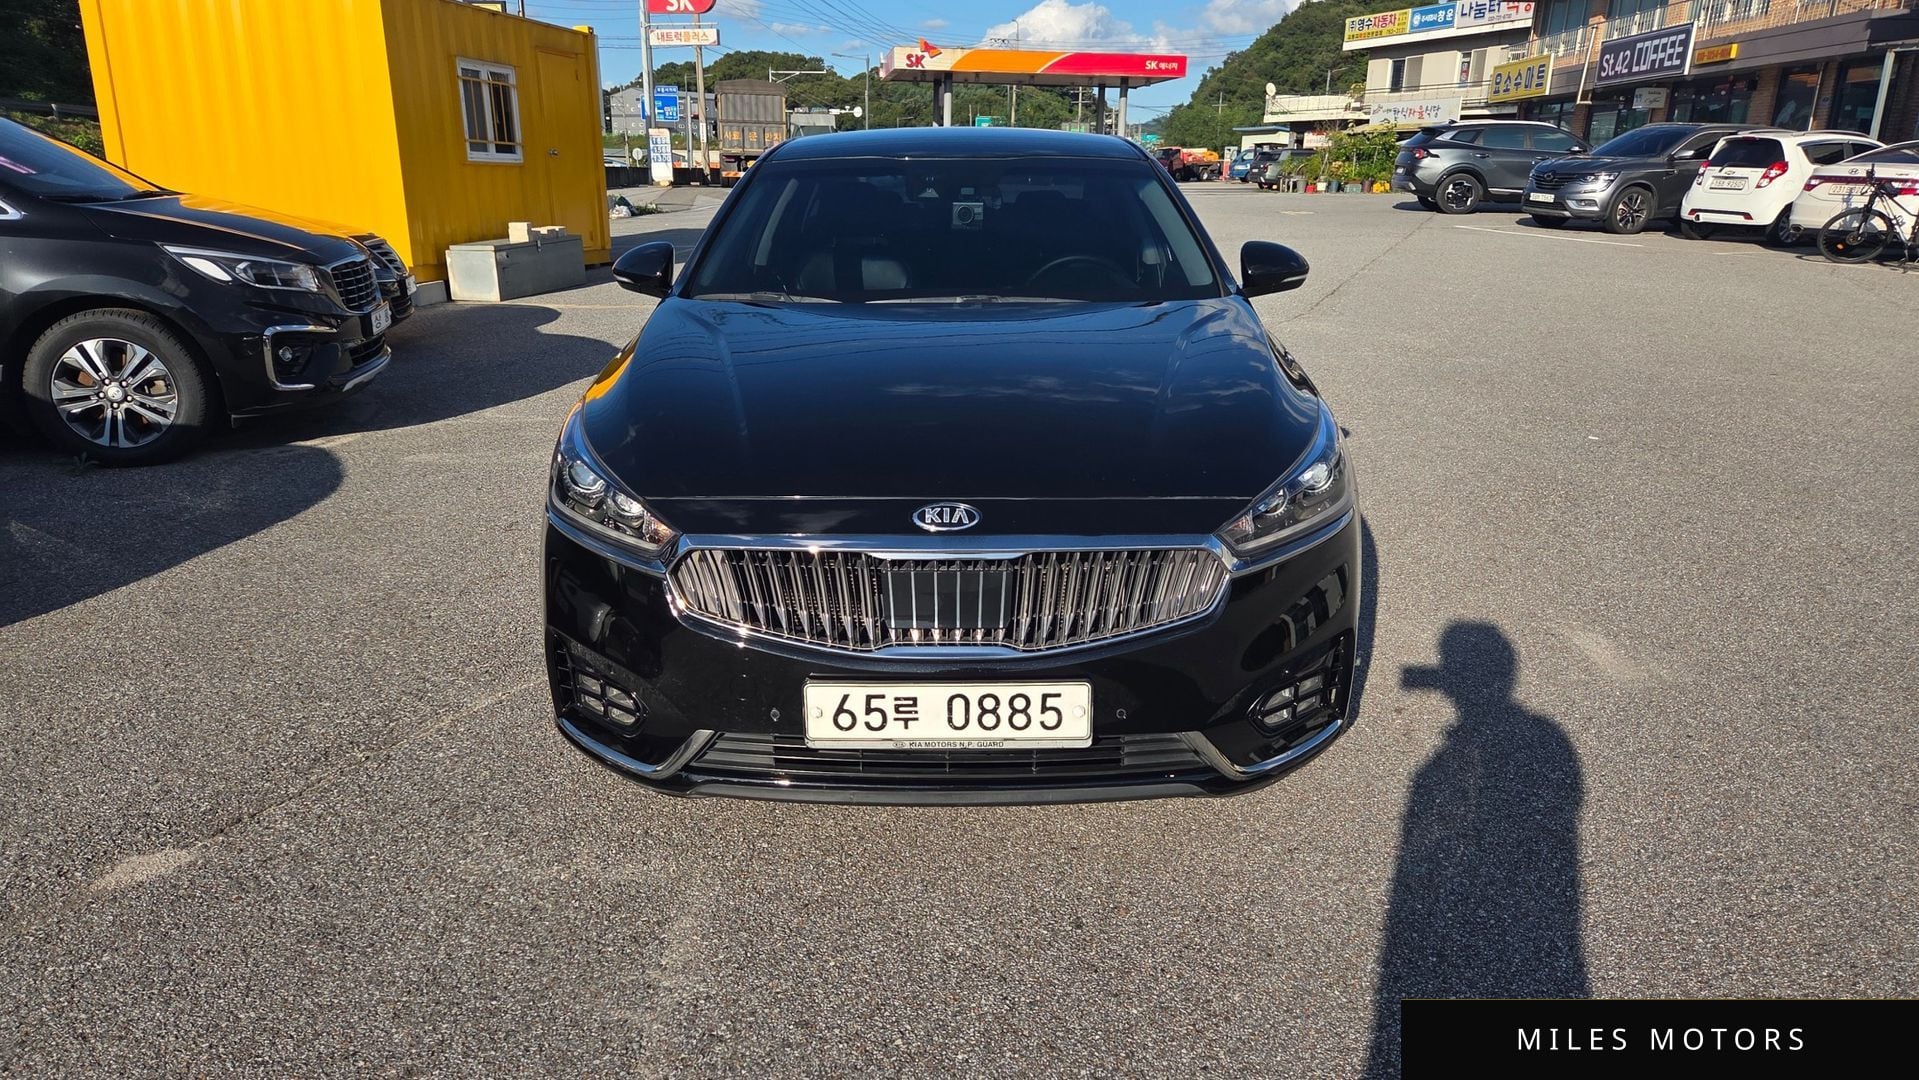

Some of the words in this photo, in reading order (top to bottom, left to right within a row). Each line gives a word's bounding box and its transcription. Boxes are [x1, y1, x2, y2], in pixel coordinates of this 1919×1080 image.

[666, 0, 695, 12] SK
[656, 31, 709, 42] 내트럭플러스
[906, 53, 926, 69] SK
[1600, 50, 1631, 77] St.42
[1631, 34, 1686, 73] COFFEE
[1493, 63, 1546, 95] 요소수마트
[925, 507, 969, 524] KIA
[832, 693, 920, 732] 65루
[946, 693, 1063, 732] 0885
